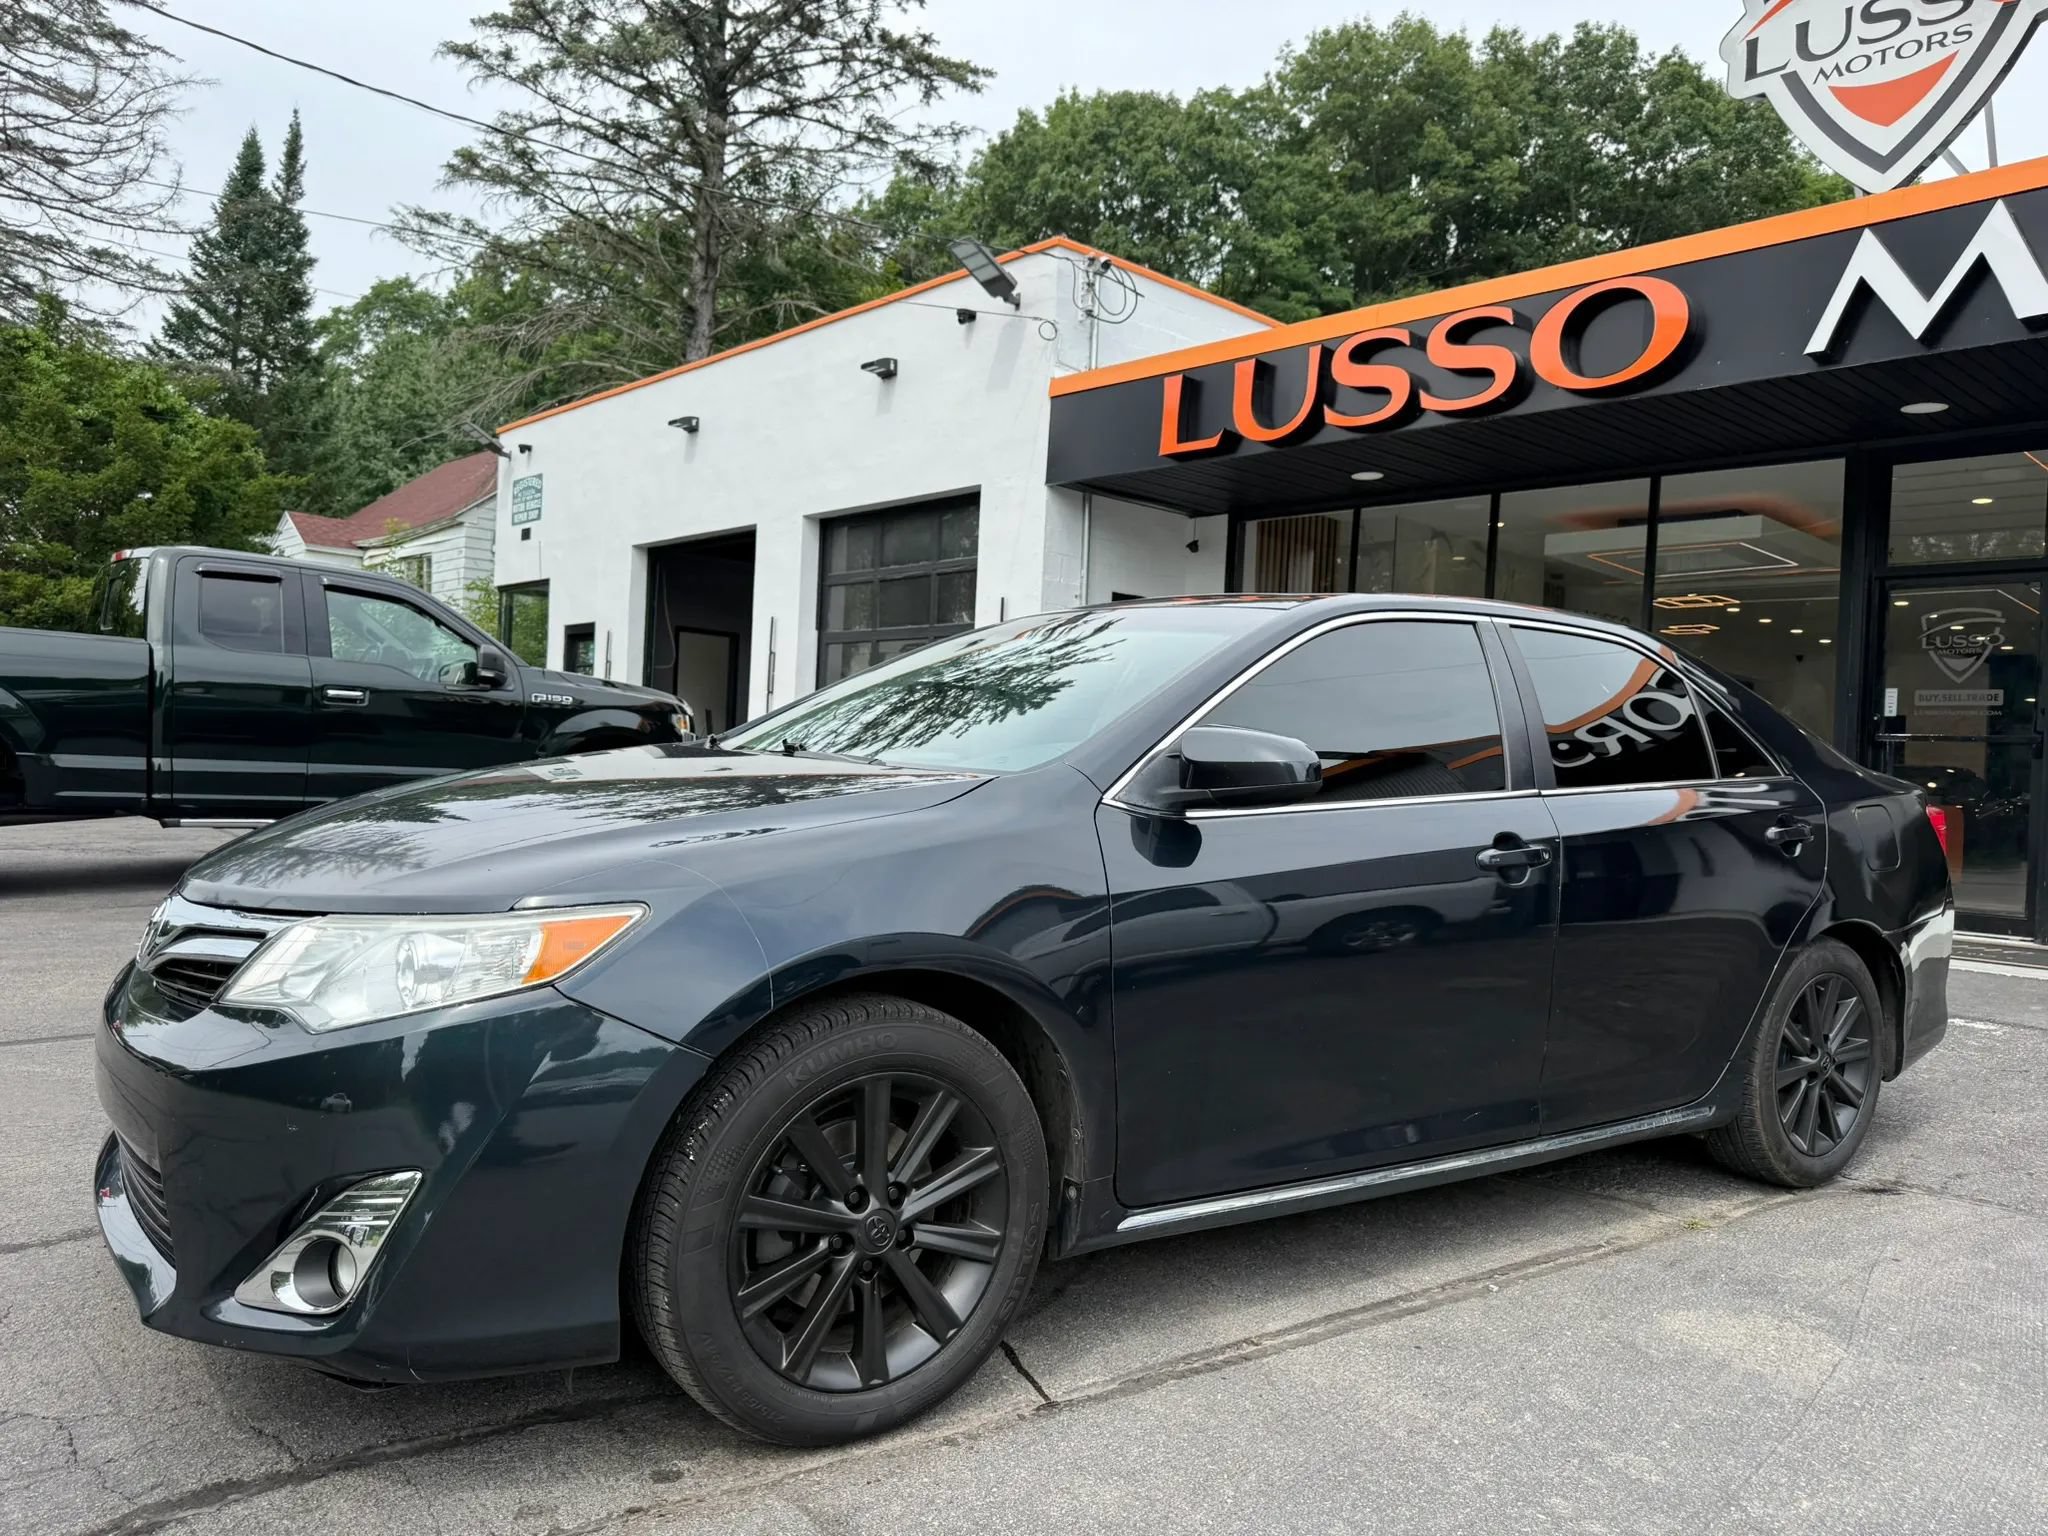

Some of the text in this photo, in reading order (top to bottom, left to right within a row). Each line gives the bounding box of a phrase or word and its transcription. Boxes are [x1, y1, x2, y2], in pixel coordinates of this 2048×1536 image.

[1812, 22, 1974, 86] MOTORS
[1158, 276, 1691, 457] LUSSO
[1921, 632, 2005, 649] LUSSO
[1936, 647, 1983, 656] MOTORS
[784, 1032, 900, 1088] KUMHO
[998, 1200, 1041, 1322] SOLUS
